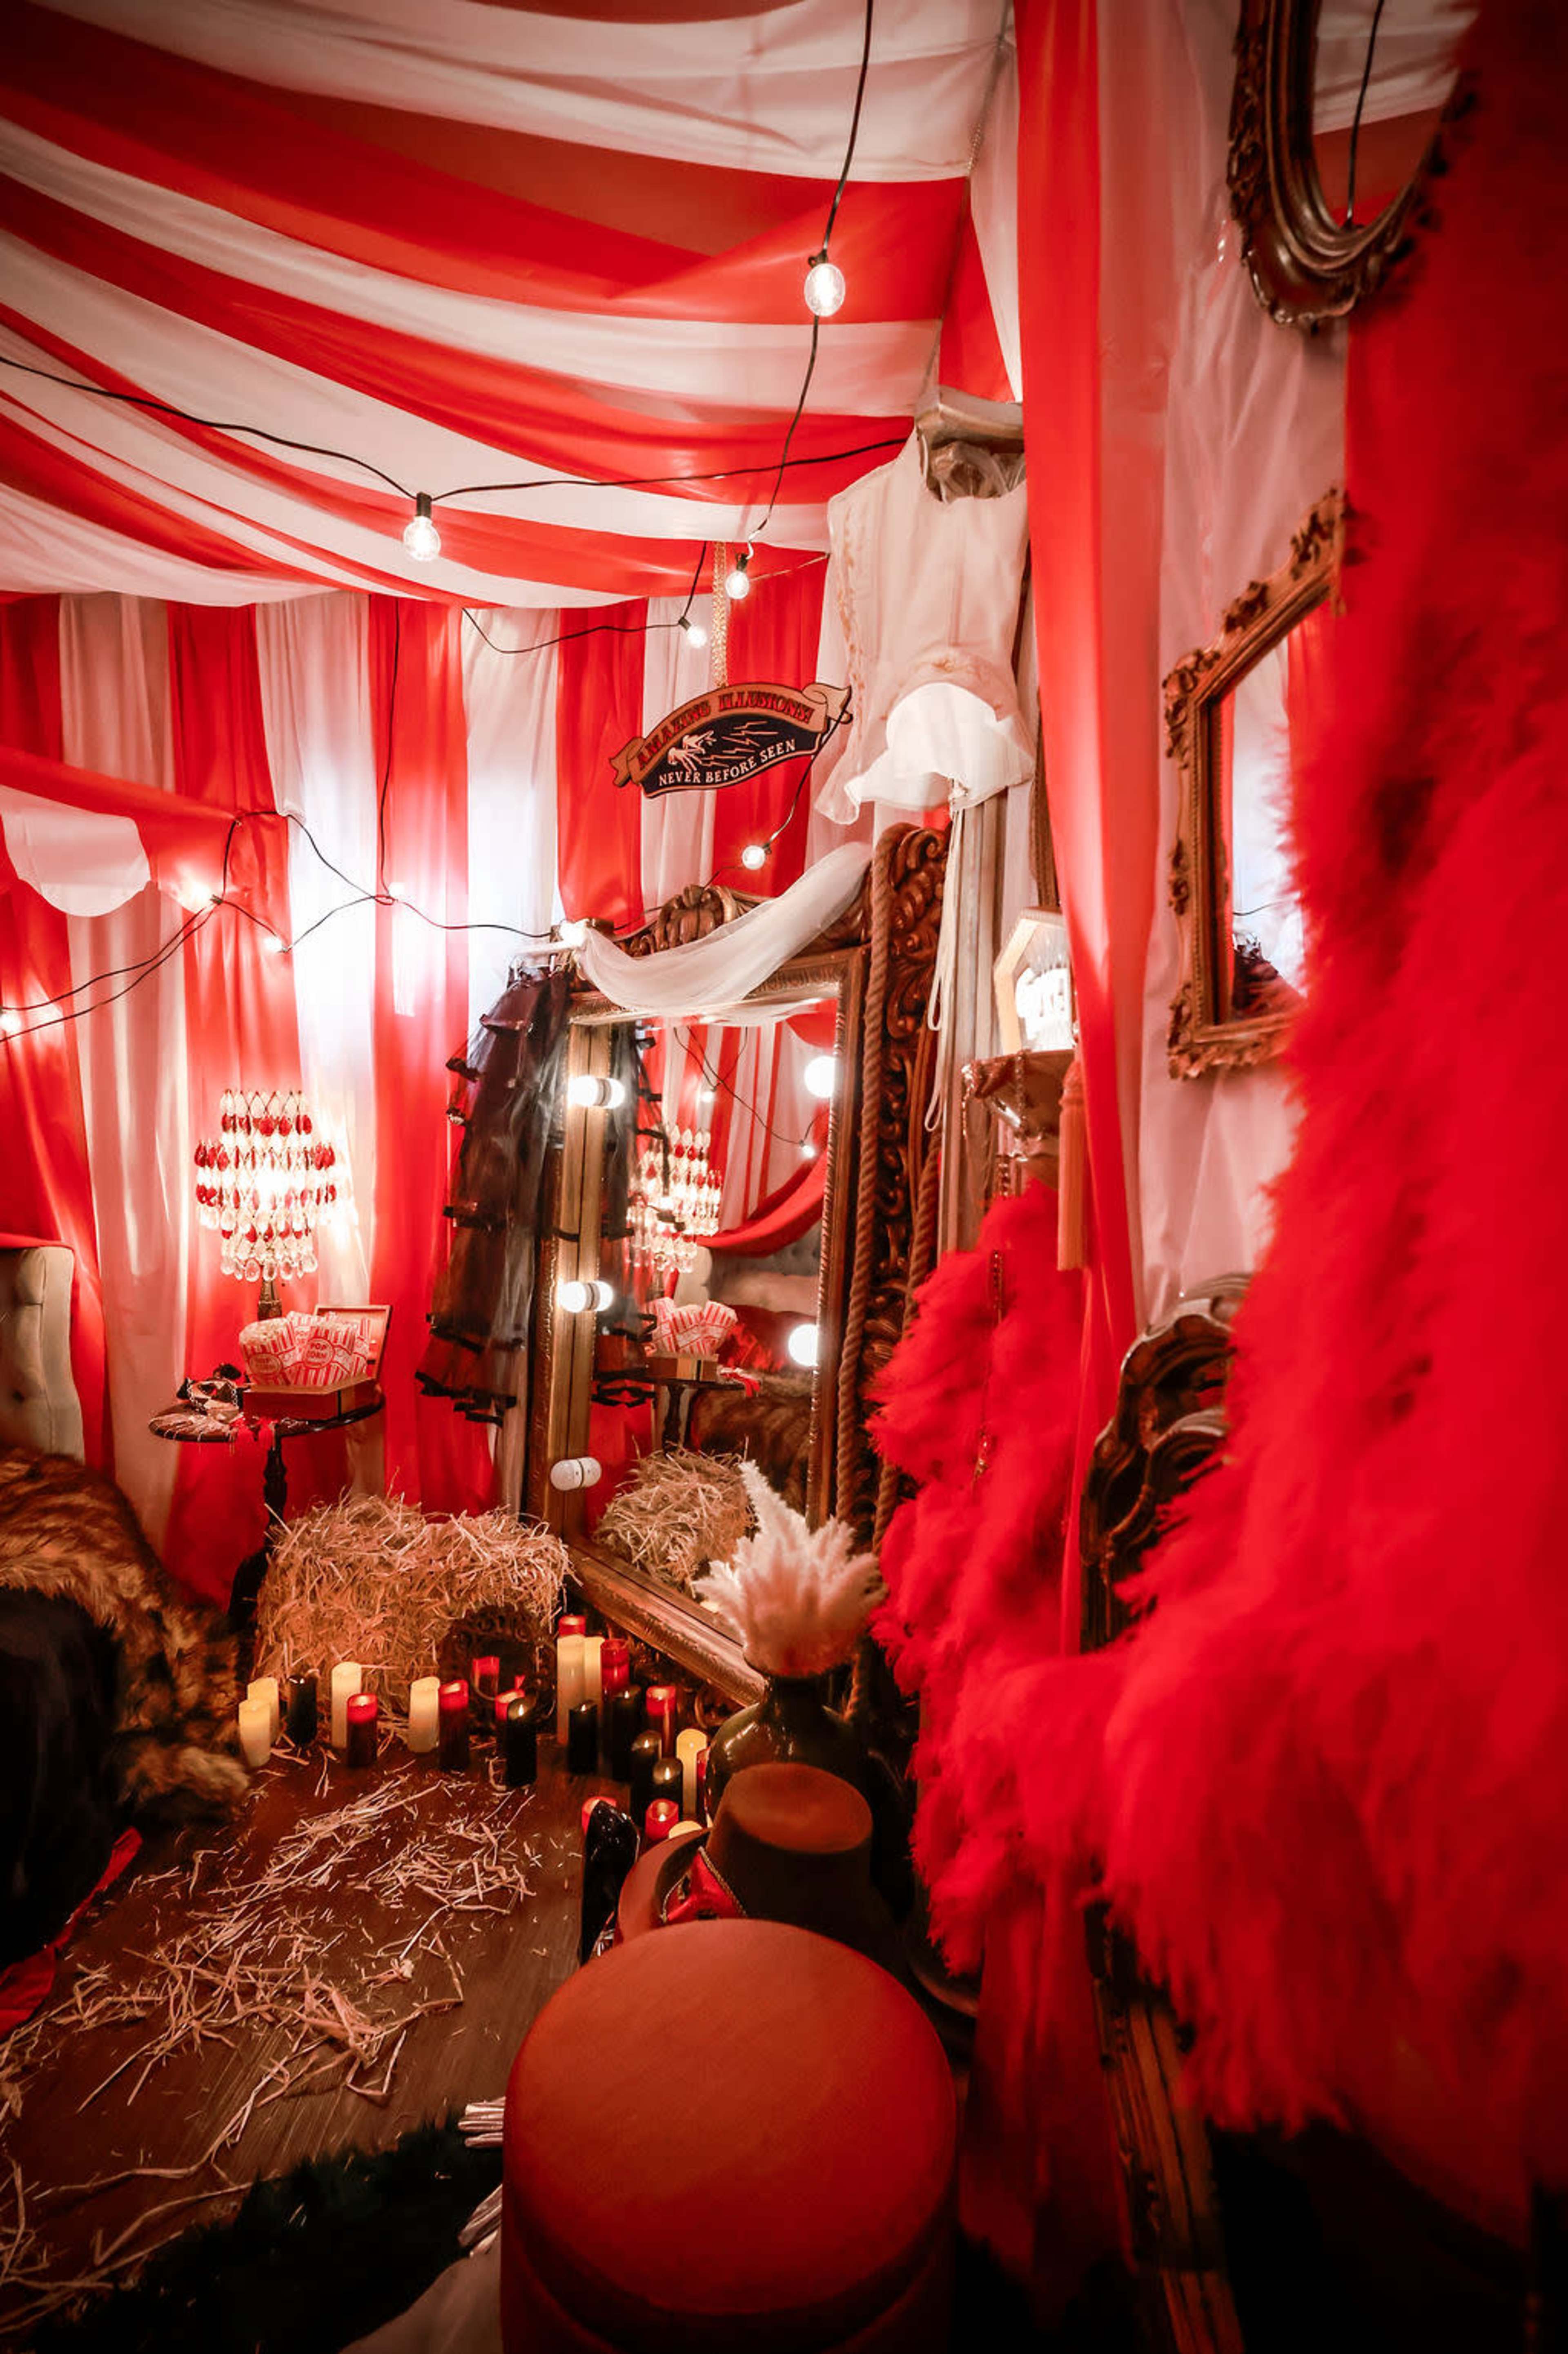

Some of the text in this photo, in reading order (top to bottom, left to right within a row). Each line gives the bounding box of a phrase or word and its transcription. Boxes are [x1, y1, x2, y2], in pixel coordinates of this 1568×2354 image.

[638, 691, 815, 771] AMAZING ILLUSIONS!
[659, 738, 796, 786] NEVER BEFORE SEEN
[306, 1350, 327, 1359] CORN
